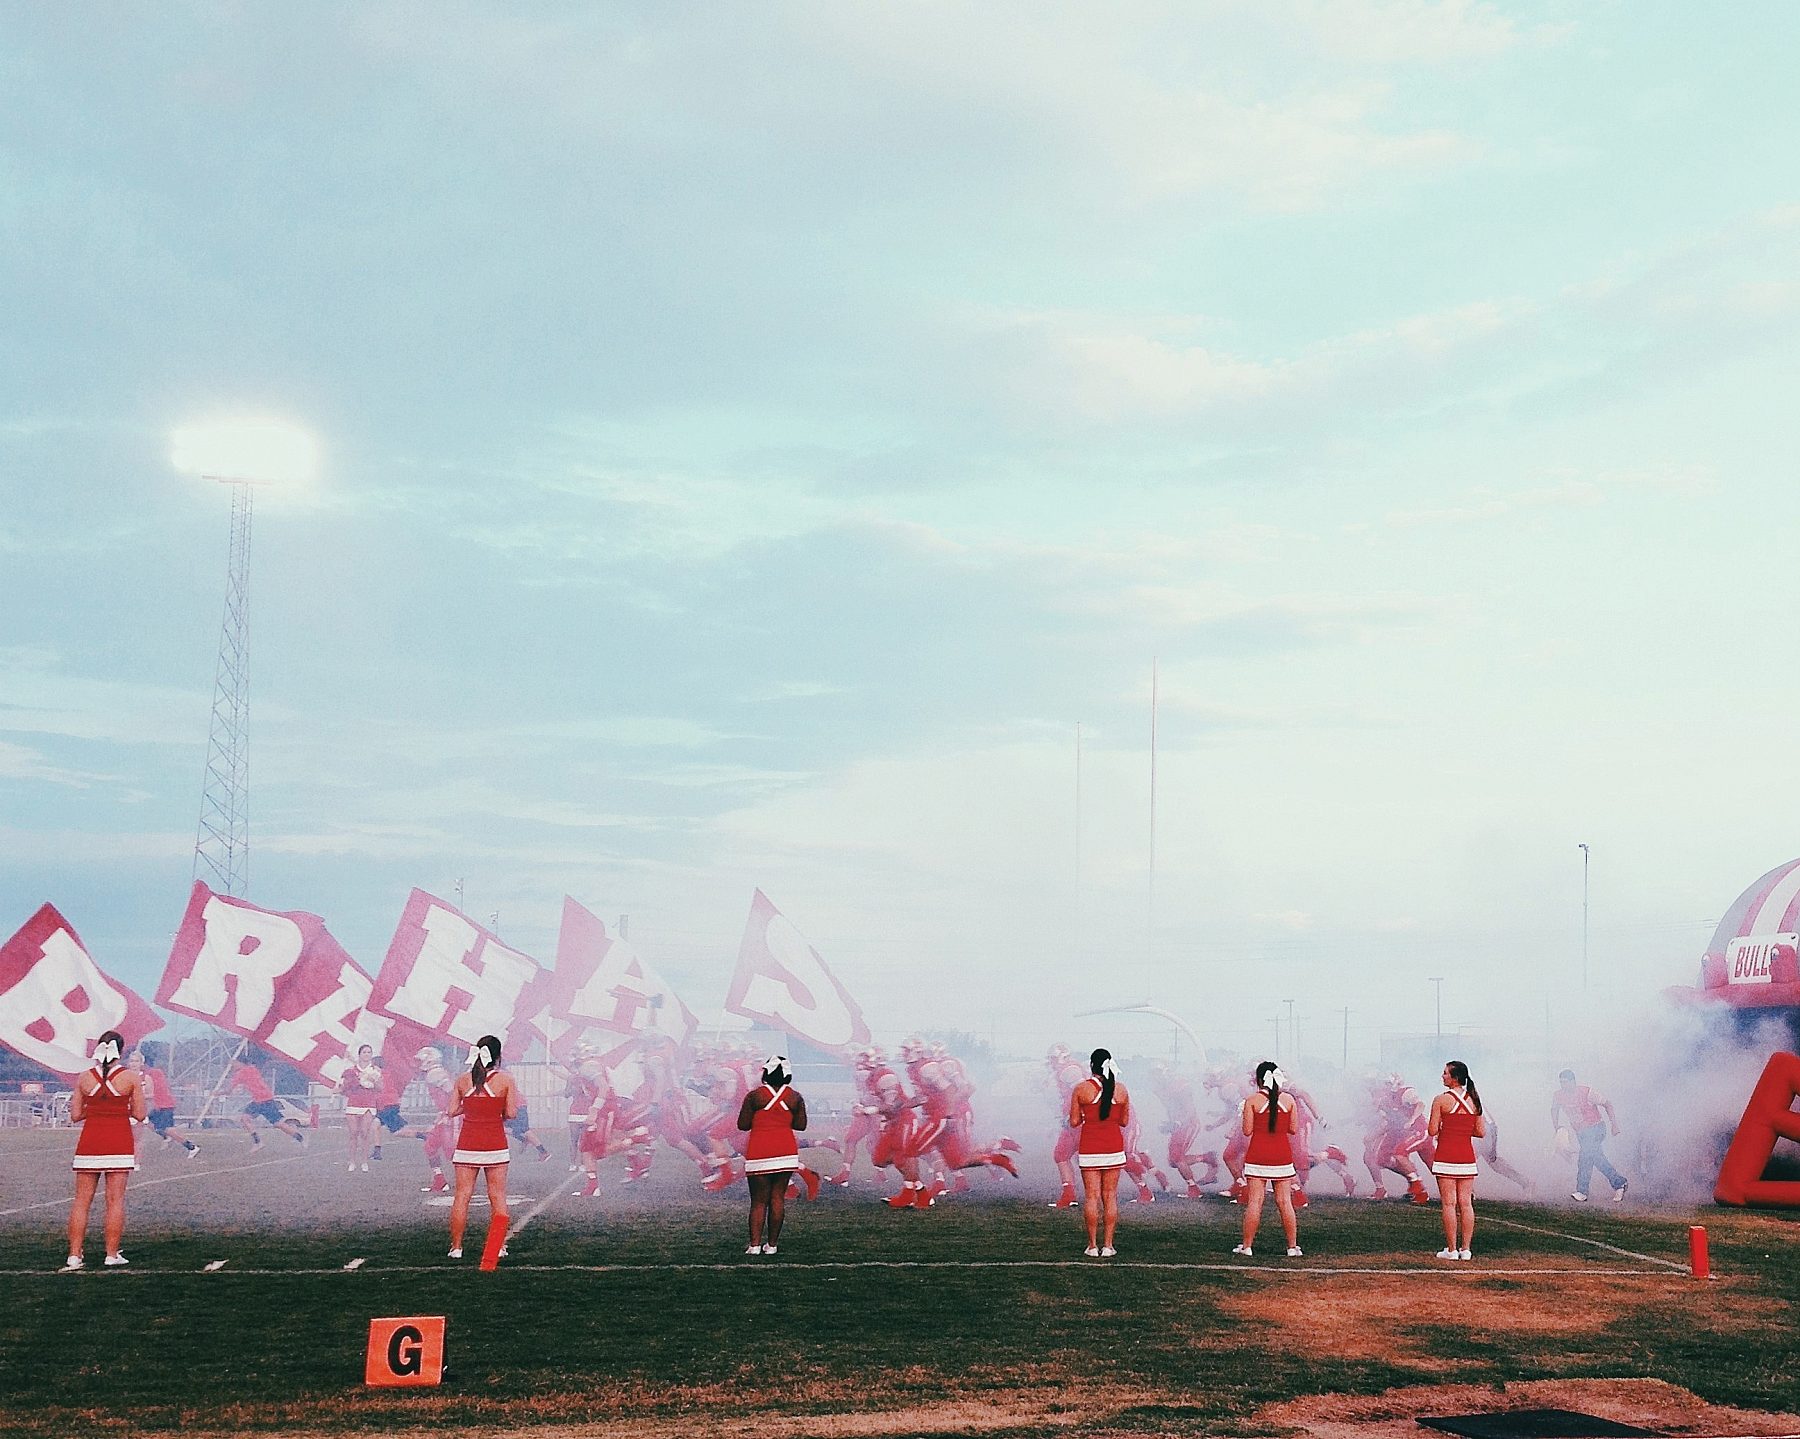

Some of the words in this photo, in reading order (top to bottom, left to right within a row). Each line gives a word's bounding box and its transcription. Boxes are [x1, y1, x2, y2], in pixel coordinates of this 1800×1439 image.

[0, 927, 128, 1074] B
[169, 895, 304, 1032] R
[384, 902, 540, 1046] H
[568, 936, 689, 1047] A
[741, 911, 854, 1045] S
[1734, 945, 1771, 978] BULL
[387, 1324, 424, 1377] G
